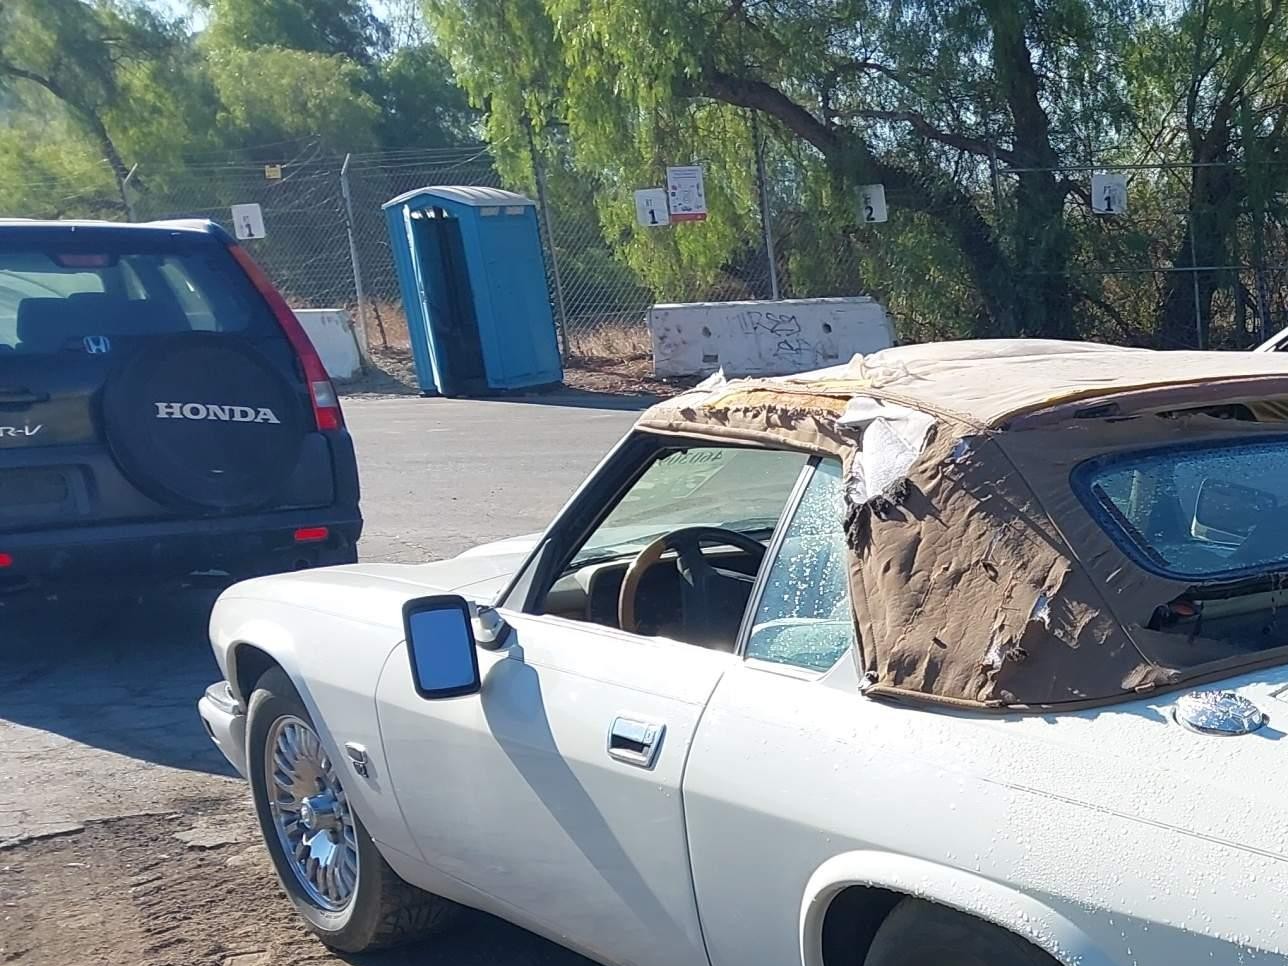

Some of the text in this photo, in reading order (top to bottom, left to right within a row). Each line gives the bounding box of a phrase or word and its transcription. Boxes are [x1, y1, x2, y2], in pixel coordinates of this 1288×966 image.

[1104, 196, 1114, 212] 1
[648, 209, 658, 225] 1
[864, 206, 875, 221] 2
[245, 223, 255, 237] 1
[155, 402, 281, 424] HONDA
